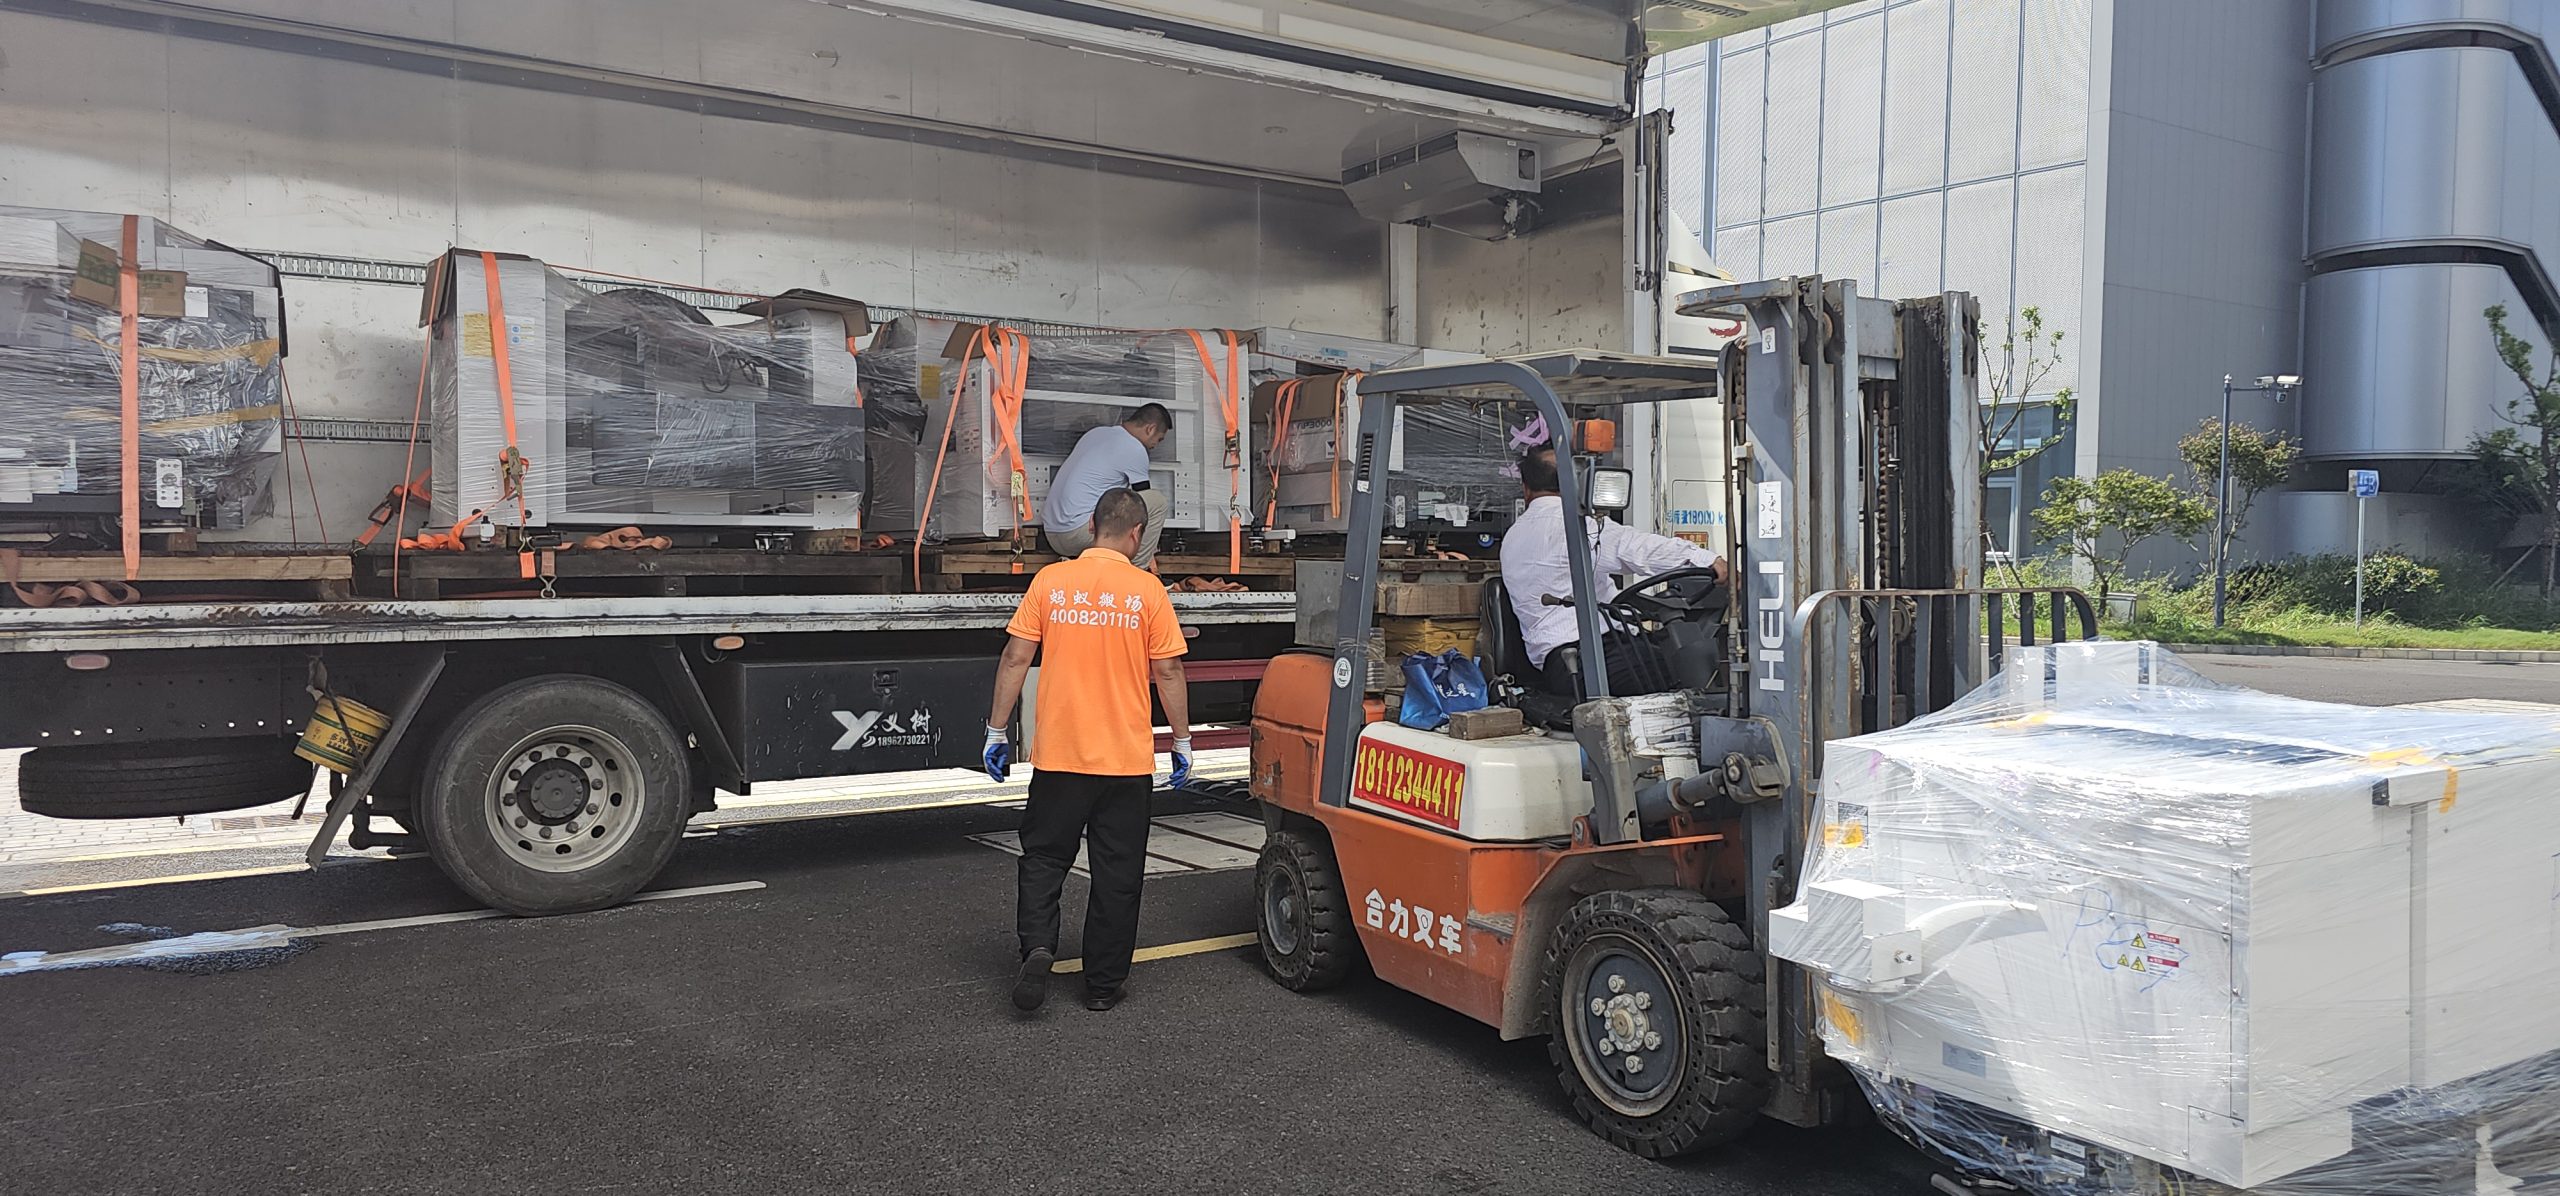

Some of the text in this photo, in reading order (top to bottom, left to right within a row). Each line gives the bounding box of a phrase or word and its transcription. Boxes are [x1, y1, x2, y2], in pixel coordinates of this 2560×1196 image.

[1049, 589, 1143, 612] 蚂蚁搬场
[1050, 609, 1140, 630] 4008201116
[1759, 561, 1784, 691] HELI
[878, 734, 930, 747] 18962730221
[1358, 744, 1464, 821] 18112344411
[1365, 888, 1462, 955] 合力叉车
